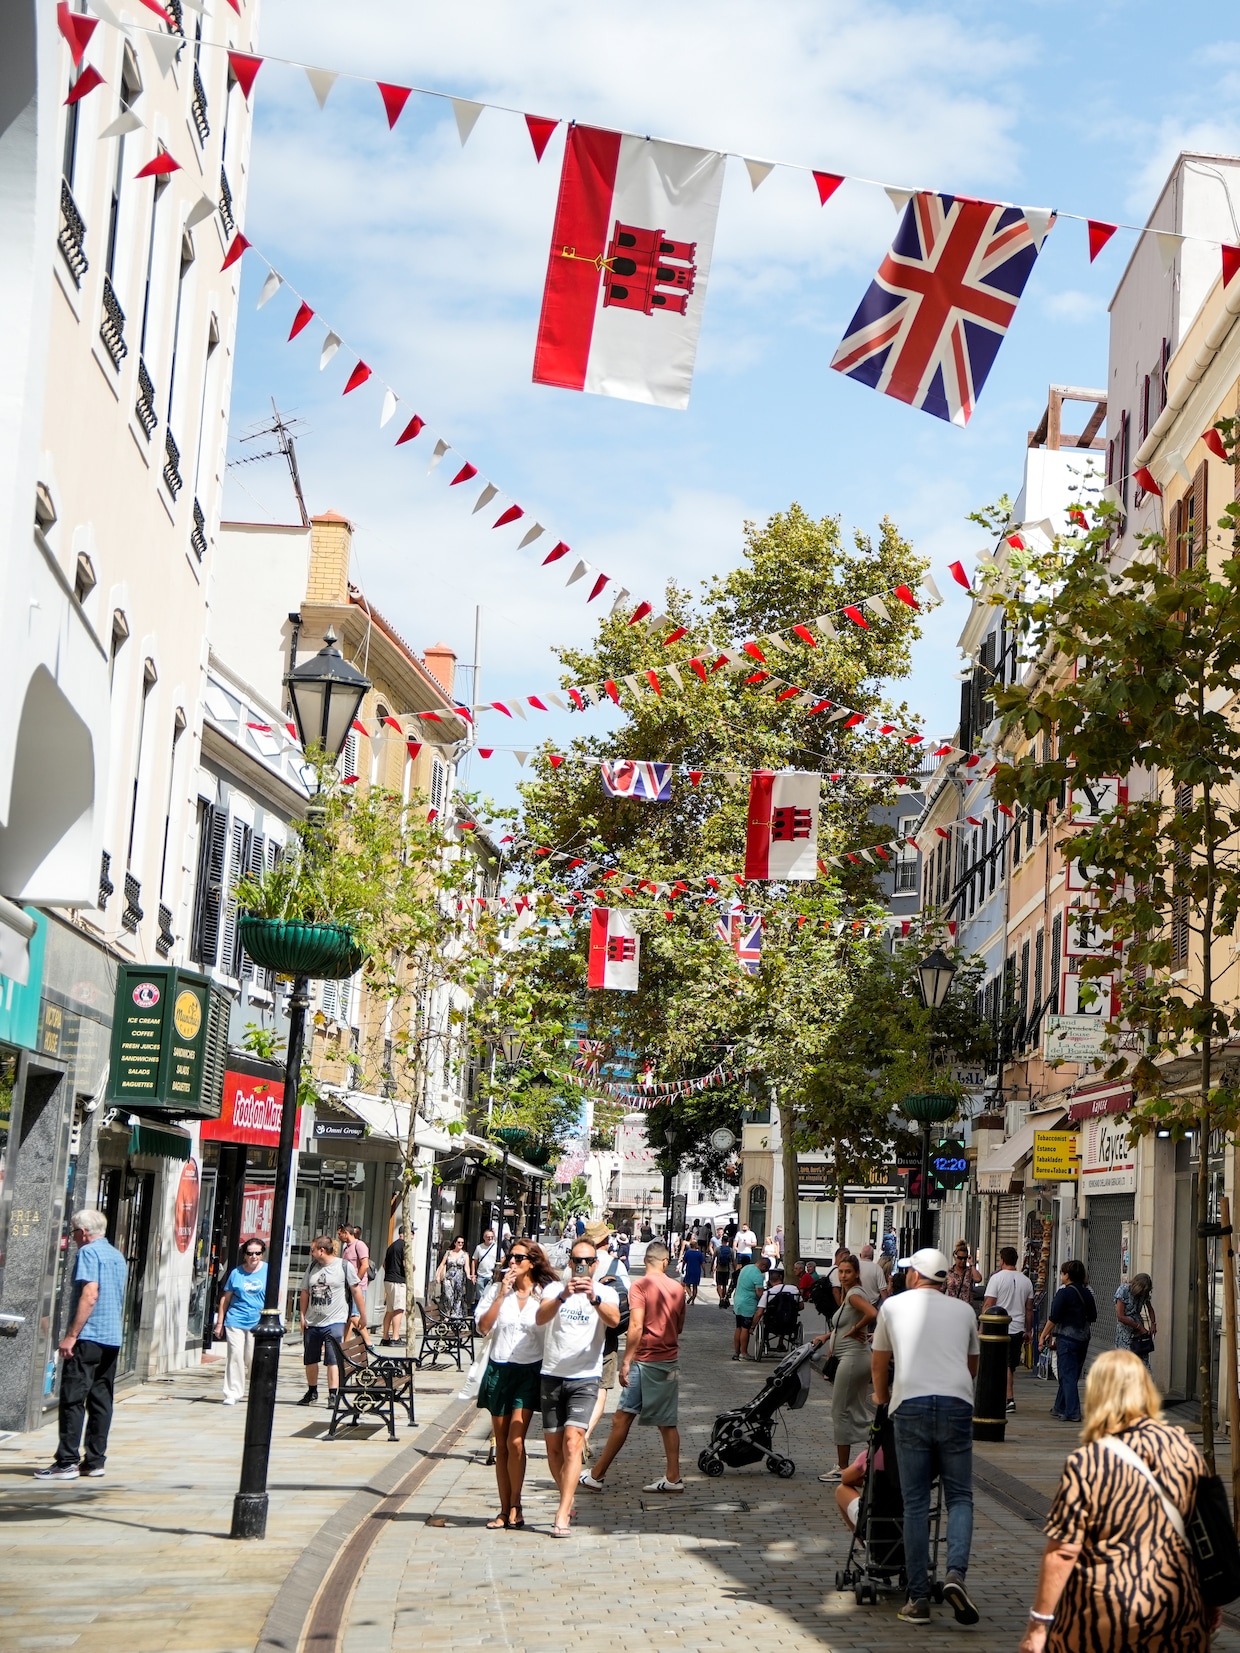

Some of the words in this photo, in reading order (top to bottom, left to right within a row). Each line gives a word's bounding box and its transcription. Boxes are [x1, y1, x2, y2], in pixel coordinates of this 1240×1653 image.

[138, 1017, 161, 1025] CREAM
[1051, 1017, 1076, 1025] Hand
[121, 1055, 159, 1063] SANDWICHES
[233, 1089, 255, 1128] Foot
[326, 1126, 343, 1134] Omni
[343, 1127, 362, 1136] Group
[933, 1157, 967, 1171] 12:20
